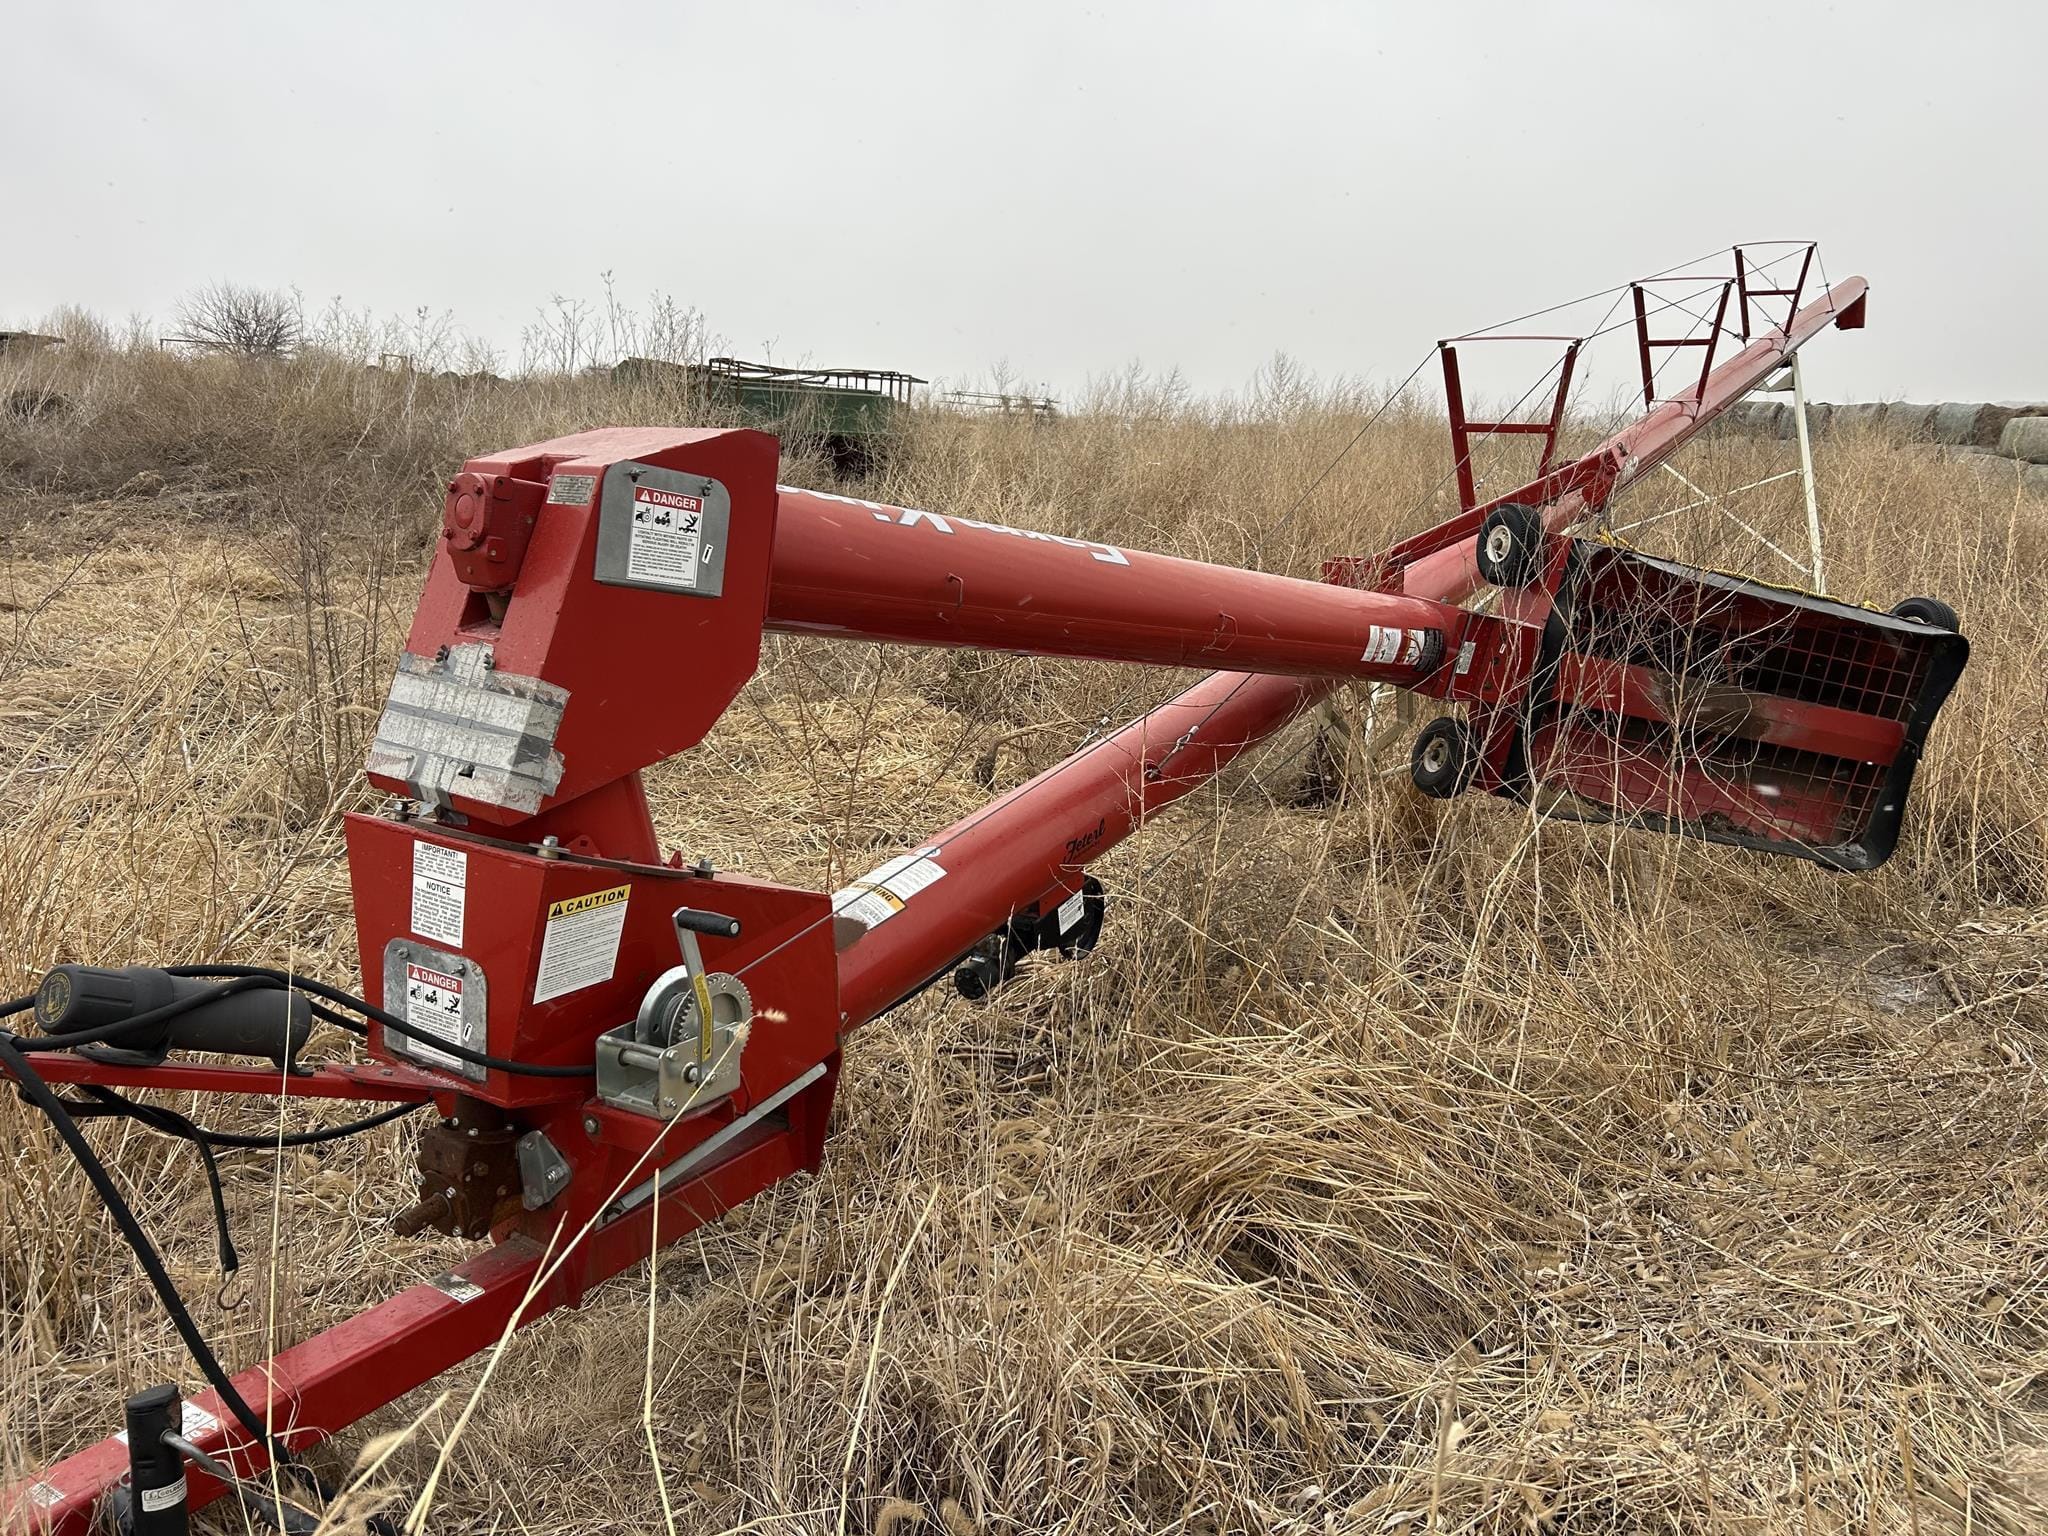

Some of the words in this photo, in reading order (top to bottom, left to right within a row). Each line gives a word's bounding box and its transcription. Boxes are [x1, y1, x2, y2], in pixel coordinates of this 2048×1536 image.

[652, 492, 697, 510] DANGER
[421, 843, 459, 859] IMPORTANT!
[426, 881, 451, 896] NOTICE
[566, 889, 626, 912] CAUTION
[421, 972, 458, 991] DANGER
